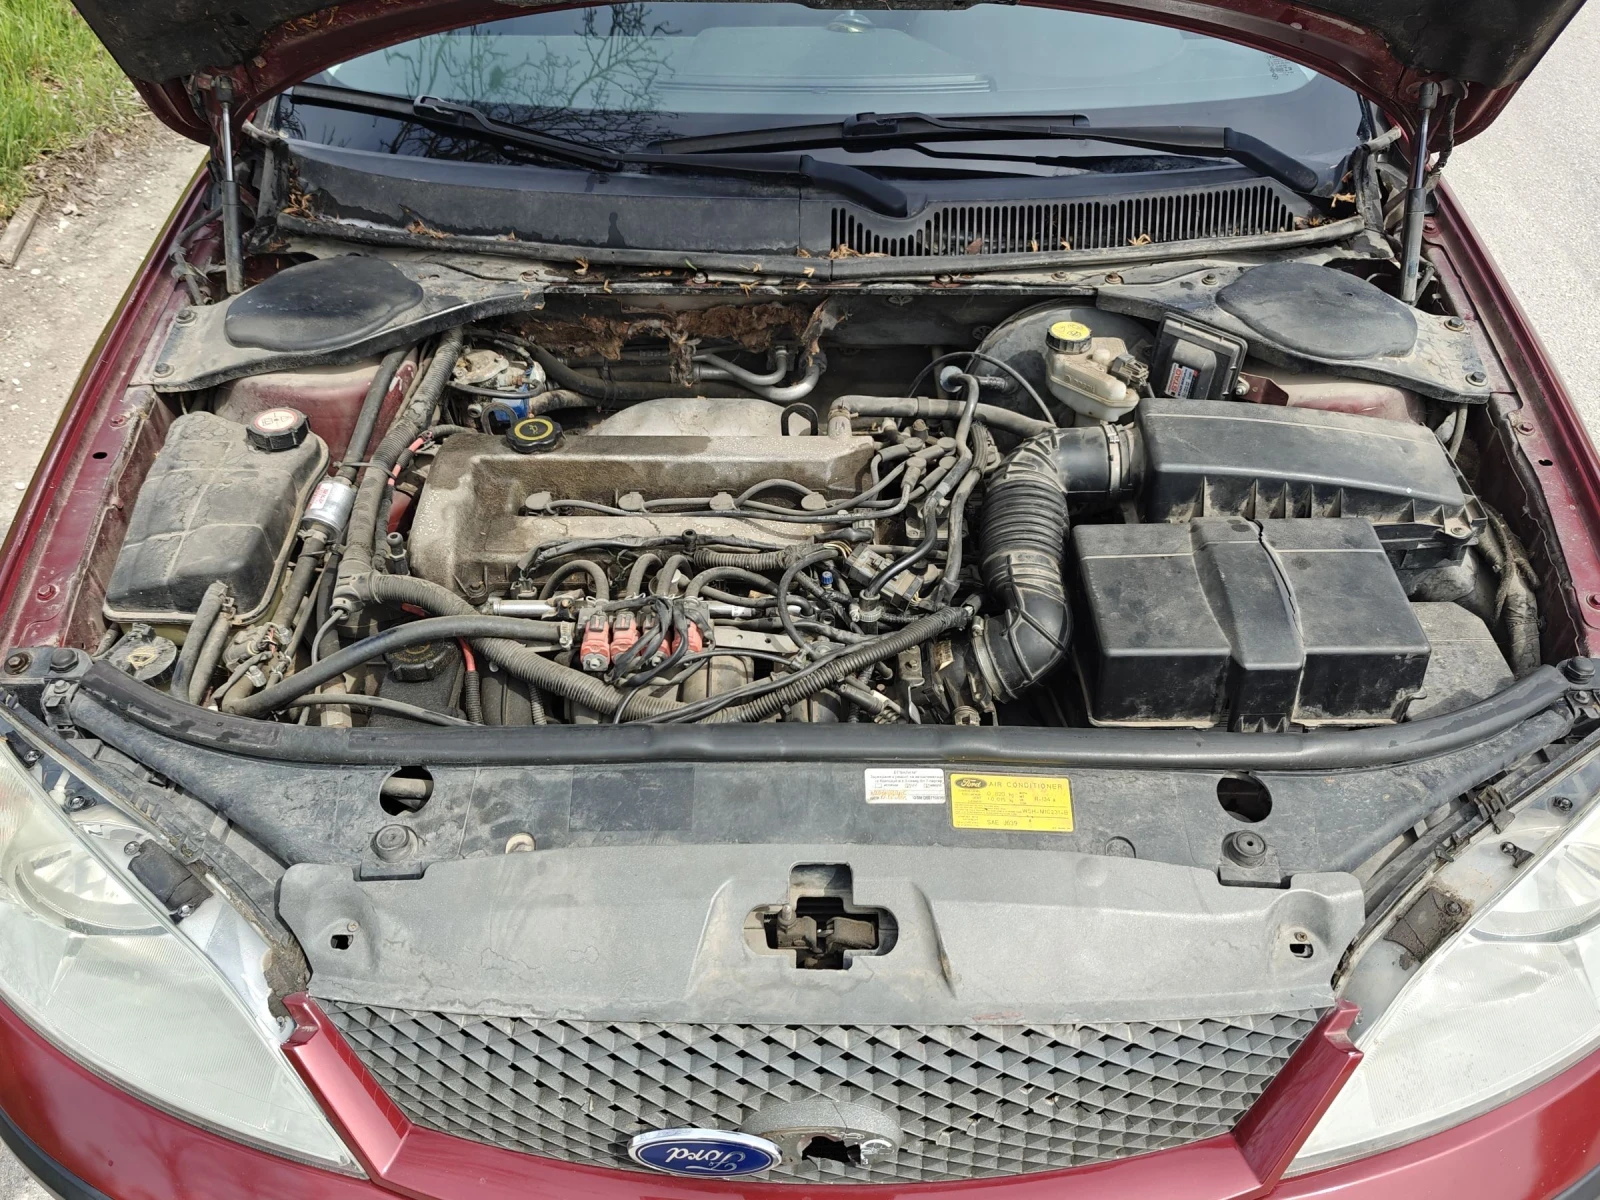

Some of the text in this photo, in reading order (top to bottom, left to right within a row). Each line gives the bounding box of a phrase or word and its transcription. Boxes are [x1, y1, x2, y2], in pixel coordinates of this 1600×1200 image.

[960, 779, 982, 788] Ford
[1006, 781, 1063, 790] CONDITIONER
[664, 1147, 746, 1172] Ford
